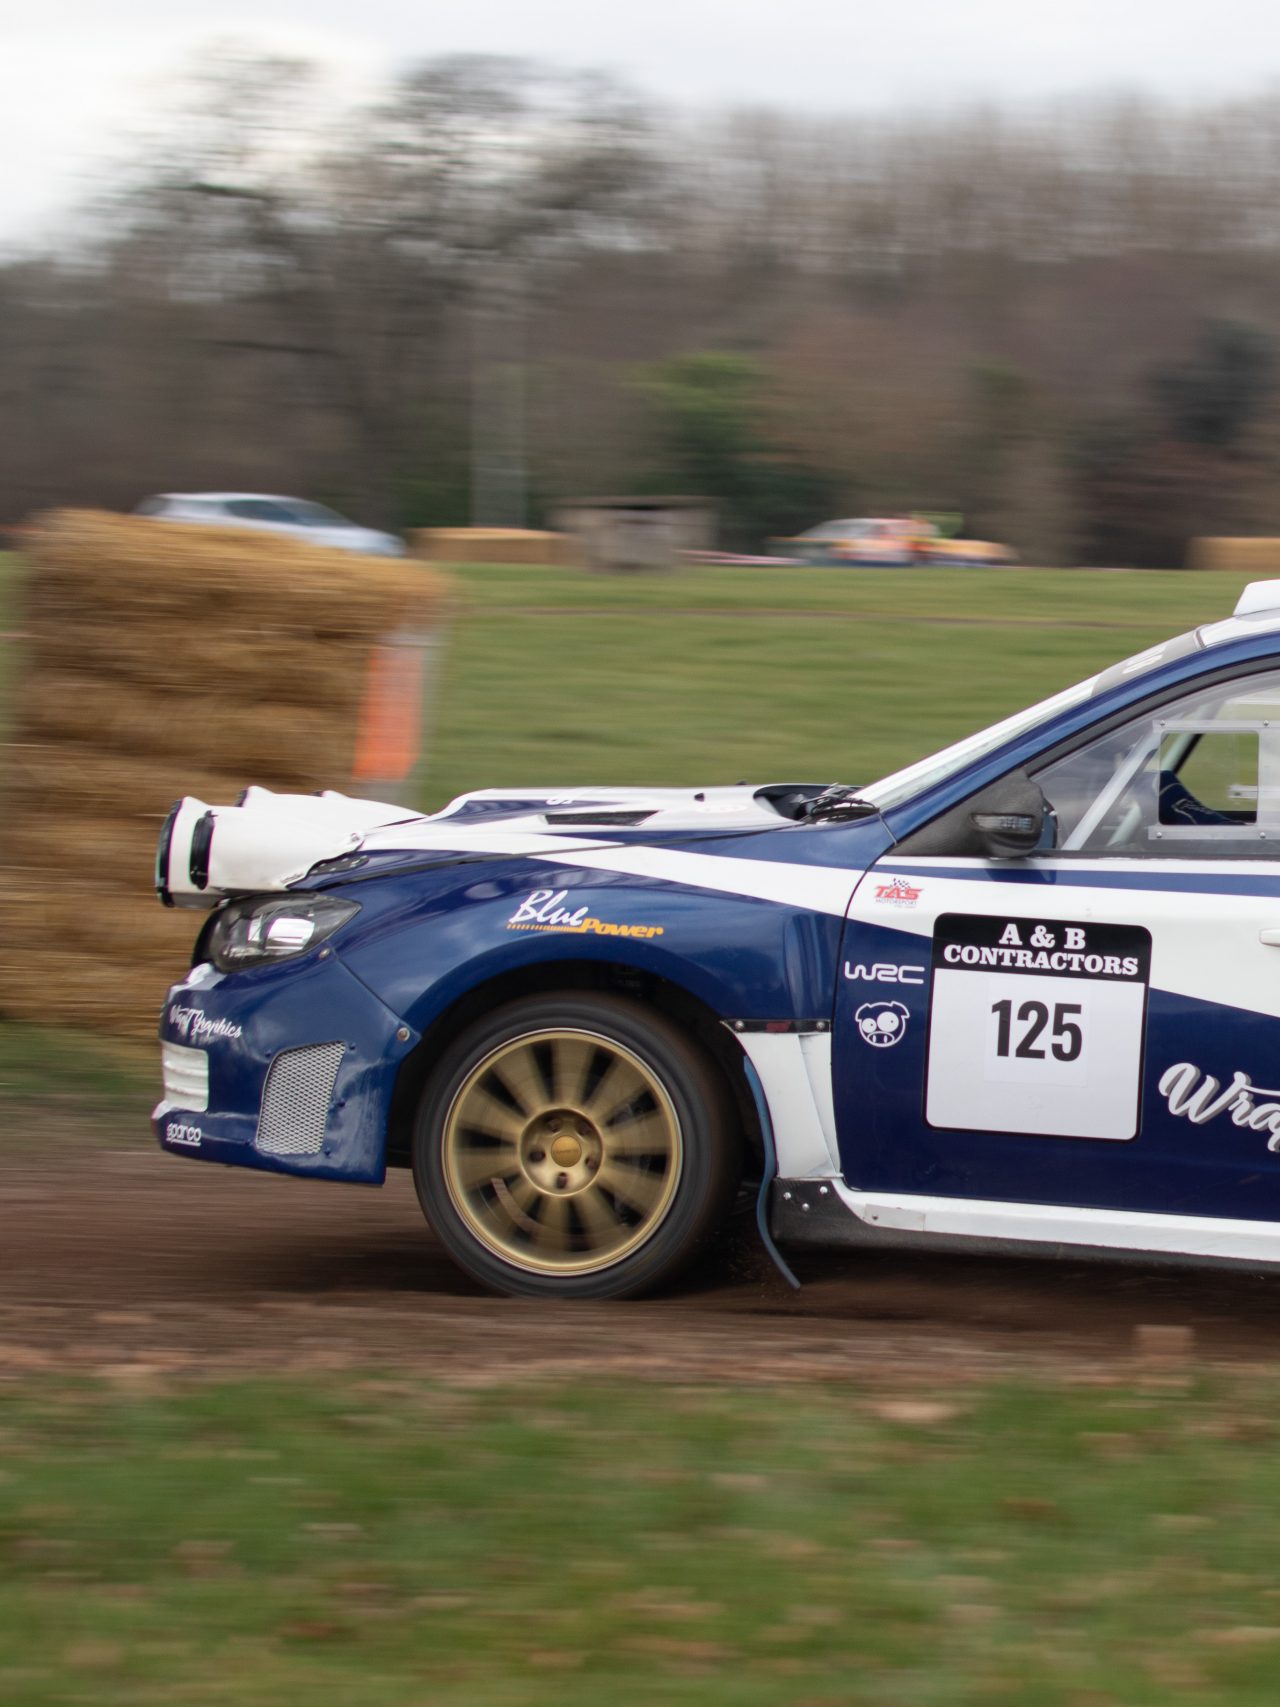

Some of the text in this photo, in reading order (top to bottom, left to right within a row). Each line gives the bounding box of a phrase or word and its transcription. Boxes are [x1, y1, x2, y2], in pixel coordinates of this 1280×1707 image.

[875, 886, 924, 900] TAS
[508, 889, 589, 926] Blue
[581, 918, 664, 938] Power
[999, 924, 1086, 949] A & B
[845, 961, 925, 984] WRC
[944, 945, 1138, 975] CONTRACTORS
[191, 1010, 242, 1038] Graphics
[991, 999, 1082, 1061] 125
